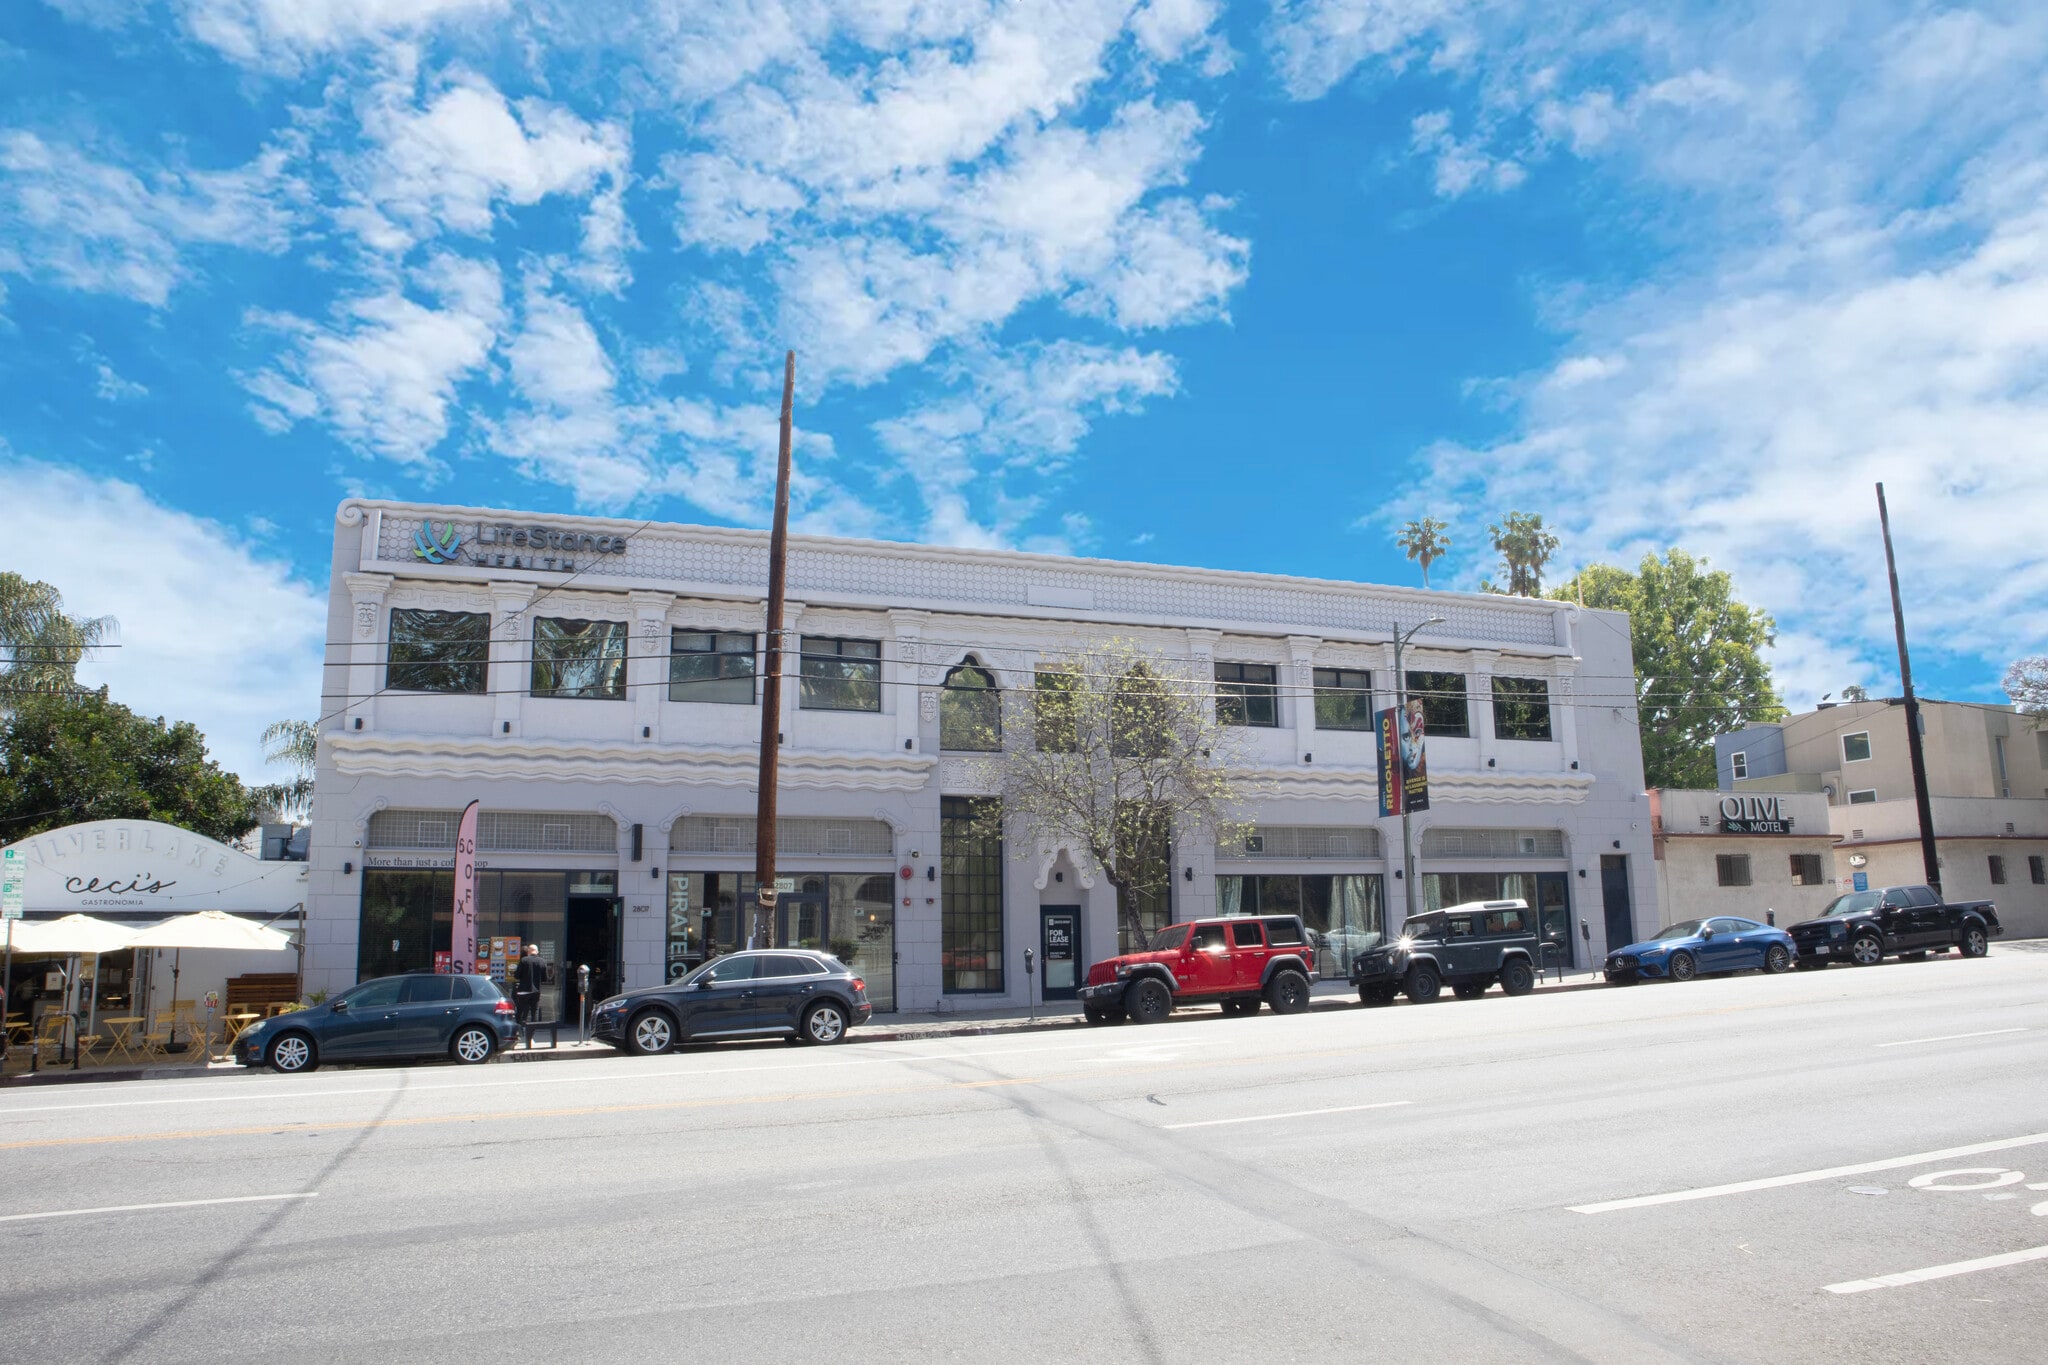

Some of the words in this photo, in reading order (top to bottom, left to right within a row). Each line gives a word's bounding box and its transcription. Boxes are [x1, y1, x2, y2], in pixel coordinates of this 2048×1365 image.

[476, 521, 627, 554] LifeStance
[476, 554, 575, 573] HEALTH
[1383, 718, 1393, 810] RIGOLETTO
[1721, 796, 1788, 820] OLIVE
[1750, 821, 1784, 832] MOTEL
[15, 828, 229, 877] ILVERLAKE
[368, 857, 391, 866] More
[393, 857, 413, 866] than
[415, 858, 431, 868] just
[632, 905, 650, 913] 2807
